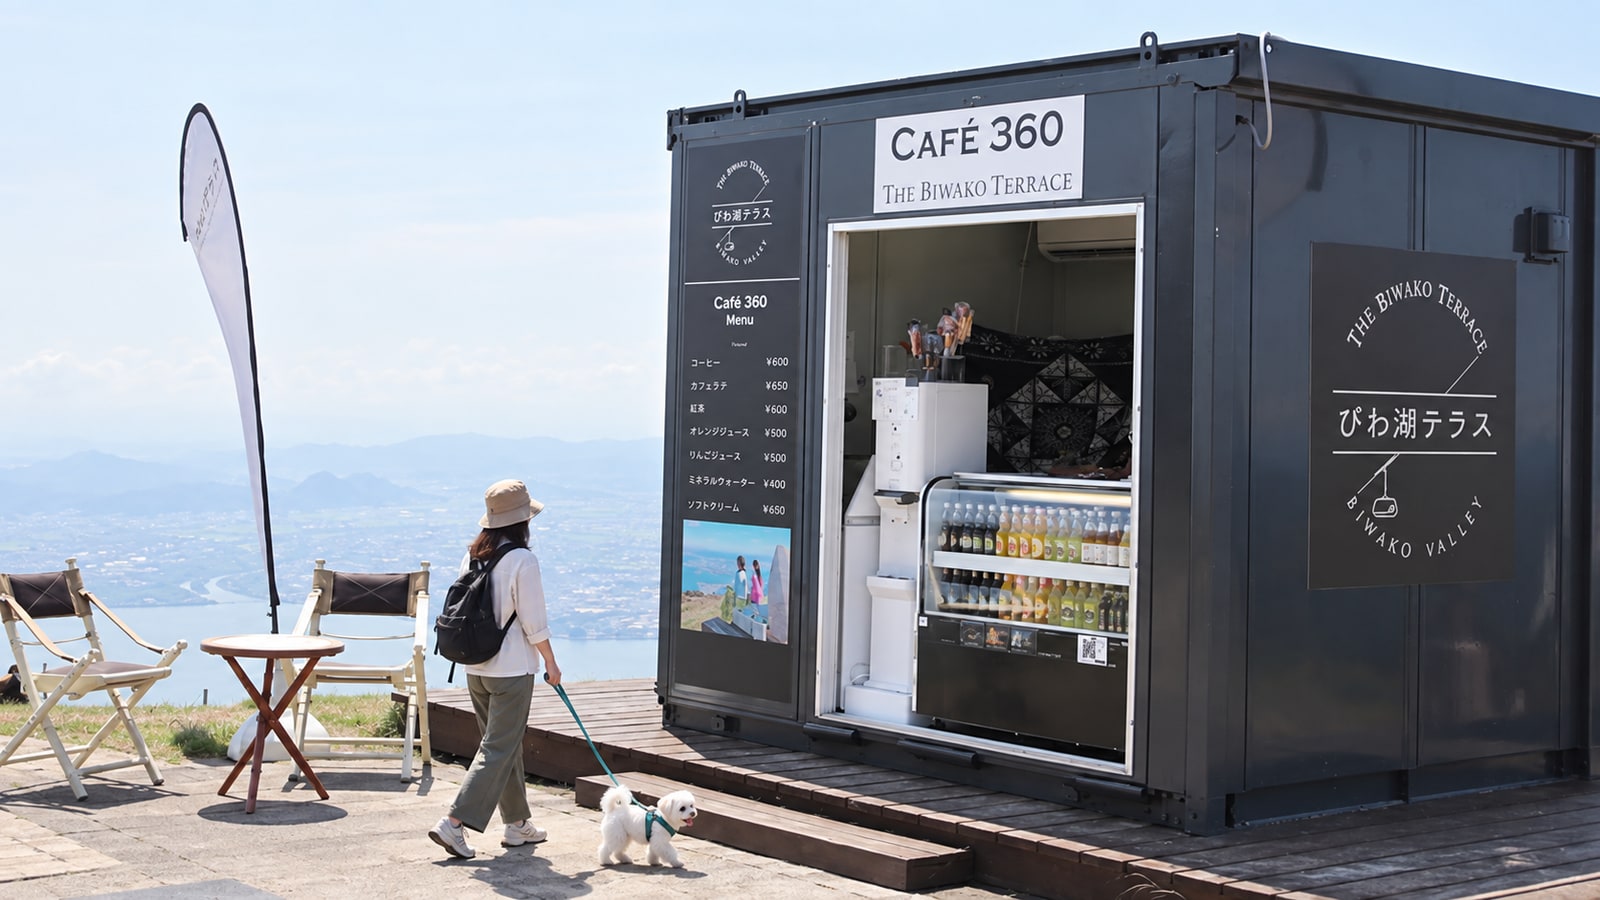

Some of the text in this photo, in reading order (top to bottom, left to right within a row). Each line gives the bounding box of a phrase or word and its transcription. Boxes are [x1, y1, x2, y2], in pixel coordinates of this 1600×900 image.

[891, 110, 1064, 161] CAFÉ 360
[883, 172, 1073, 204] THE BIWAKO TERRACE
[713, 295, 768, 309] Café 360
[726, 314, 754, 326] Menu
[1347, 280, 1488, 354] THE BIWAKO TERRACE
[766, 357, 789, 367] ¥600
[690, 381, 788, 391] カフェラテ ¥650
[765, 404, 788, 414] ¥600
[689, 427, 787, 438] オレンジジュース ¥500
[689, 450, 787, 463] りんごジュース ¥500
[689, 475, 786, 489] ミネラルウォーター ¥400
[688, 501, 786, 515] ソフトクリーム ¥650
[1346, 496, 1482, 558] BIWAKO VALLEY
